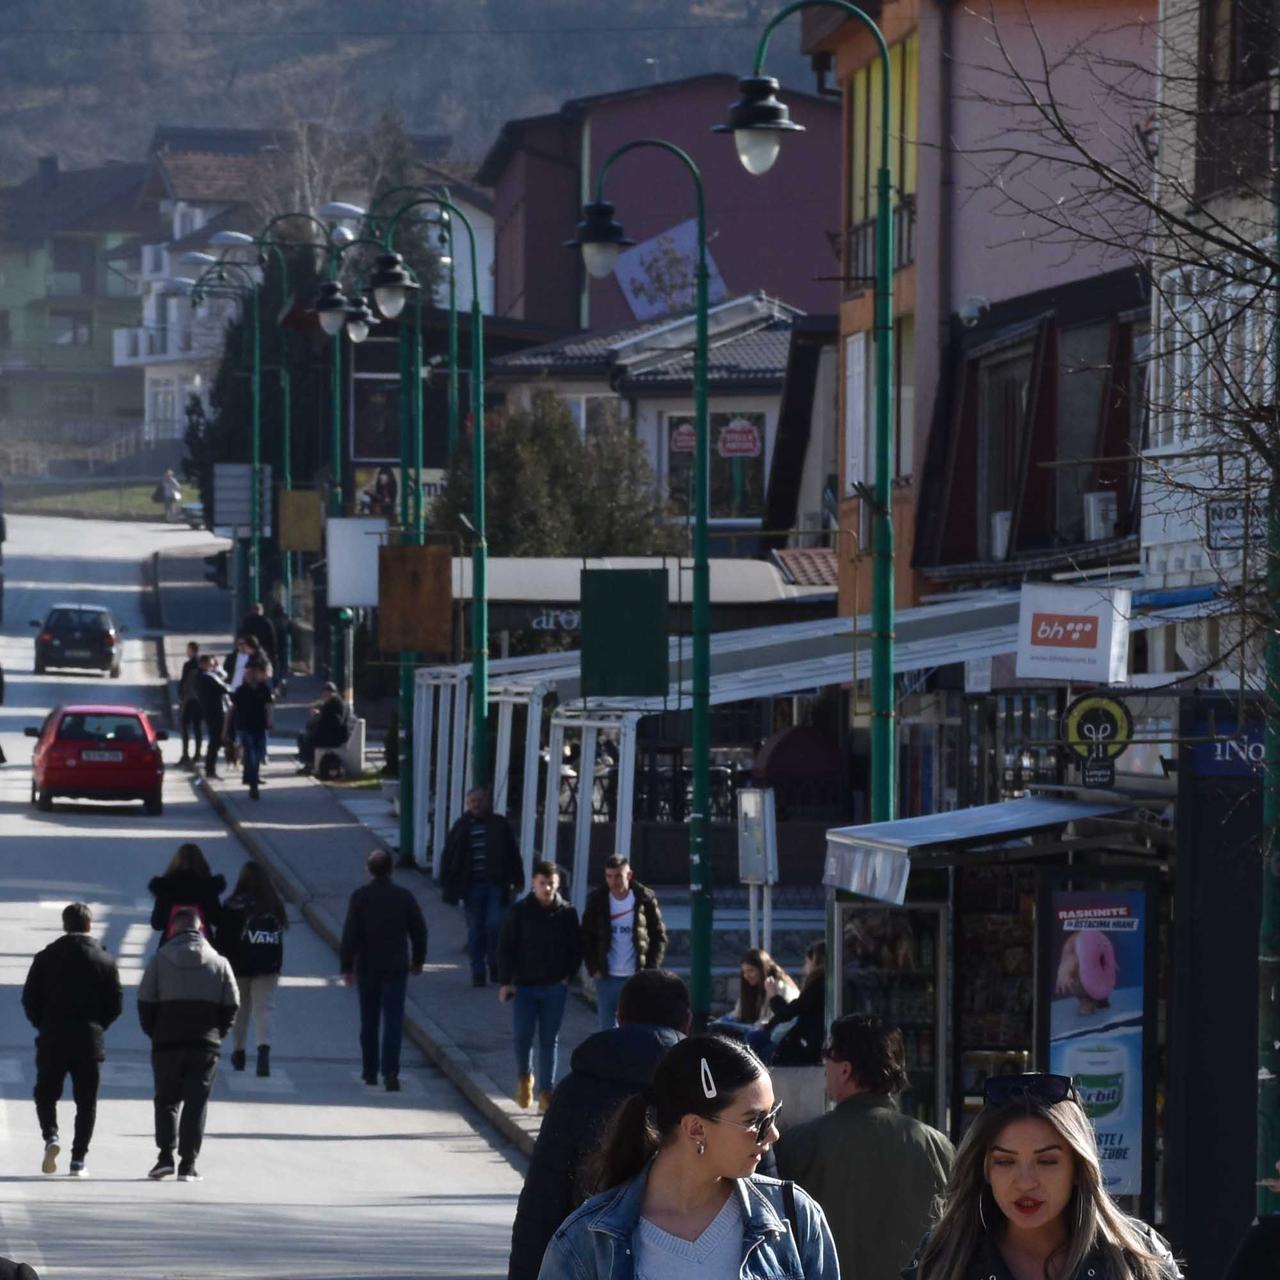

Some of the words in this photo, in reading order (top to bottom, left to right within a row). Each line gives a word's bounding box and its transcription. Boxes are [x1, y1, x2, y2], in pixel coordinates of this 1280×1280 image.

[1037, 622, 1064, 639] bh
[1058, 906, 1128, 920] RASKINITE
[1102, 1148, 1131, 1160] ZUBE
